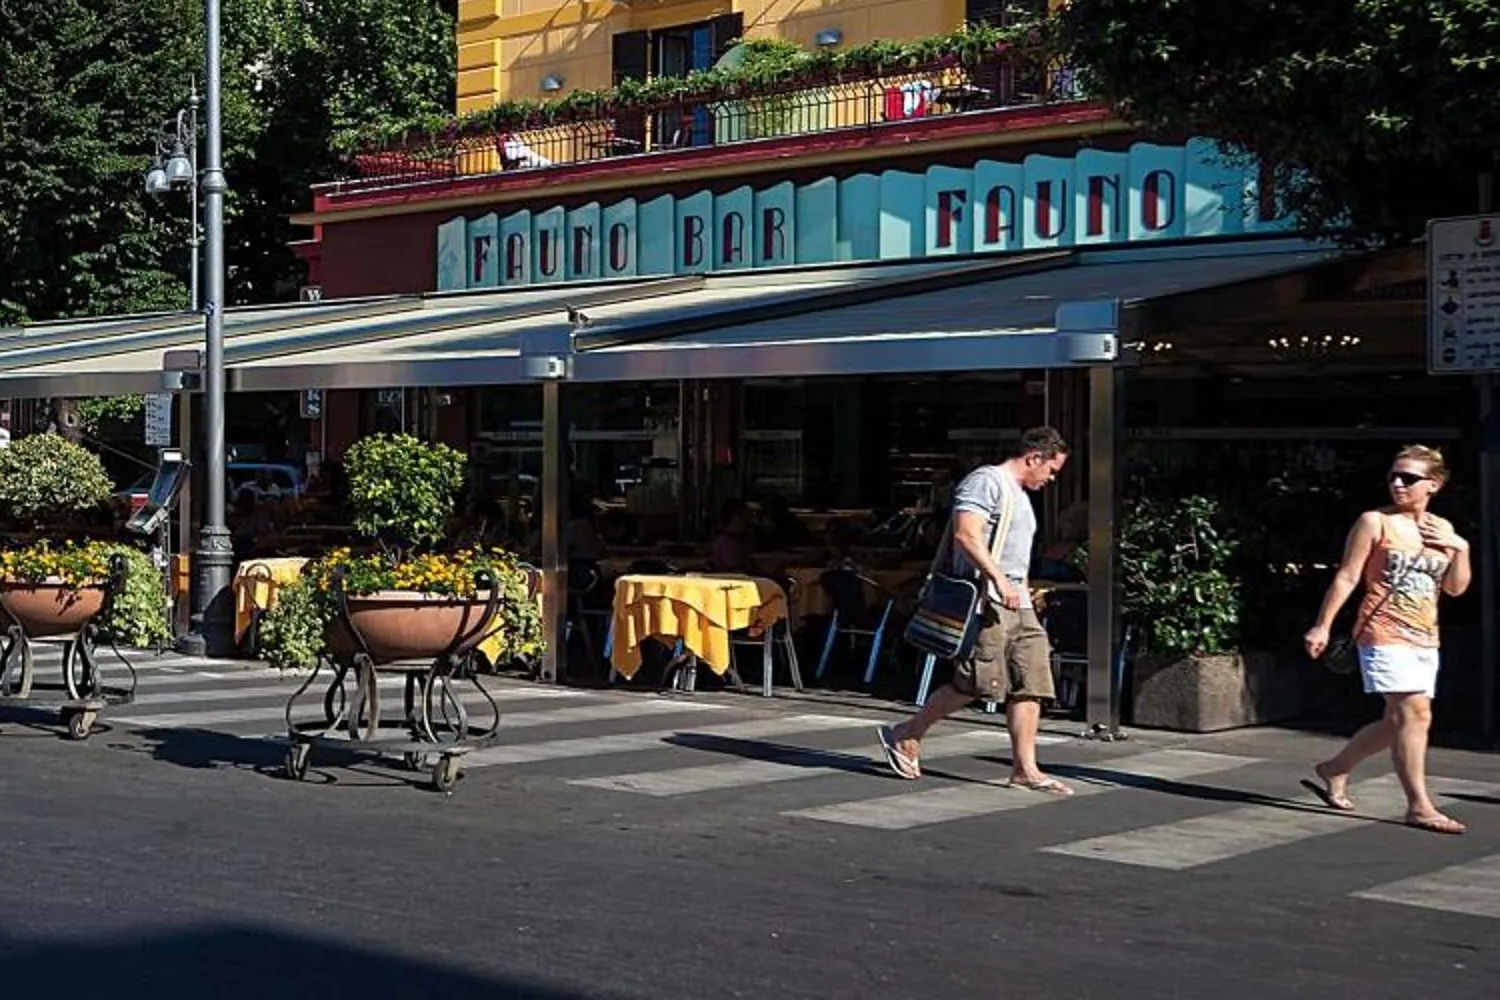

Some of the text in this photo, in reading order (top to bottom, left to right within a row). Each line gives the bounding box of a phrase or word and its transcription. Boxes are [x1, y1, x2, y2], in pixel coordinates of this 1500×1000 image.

[474, 207, 785, 282] FAUNO BAR
[936, 169, 1176, 249] FAUNO
